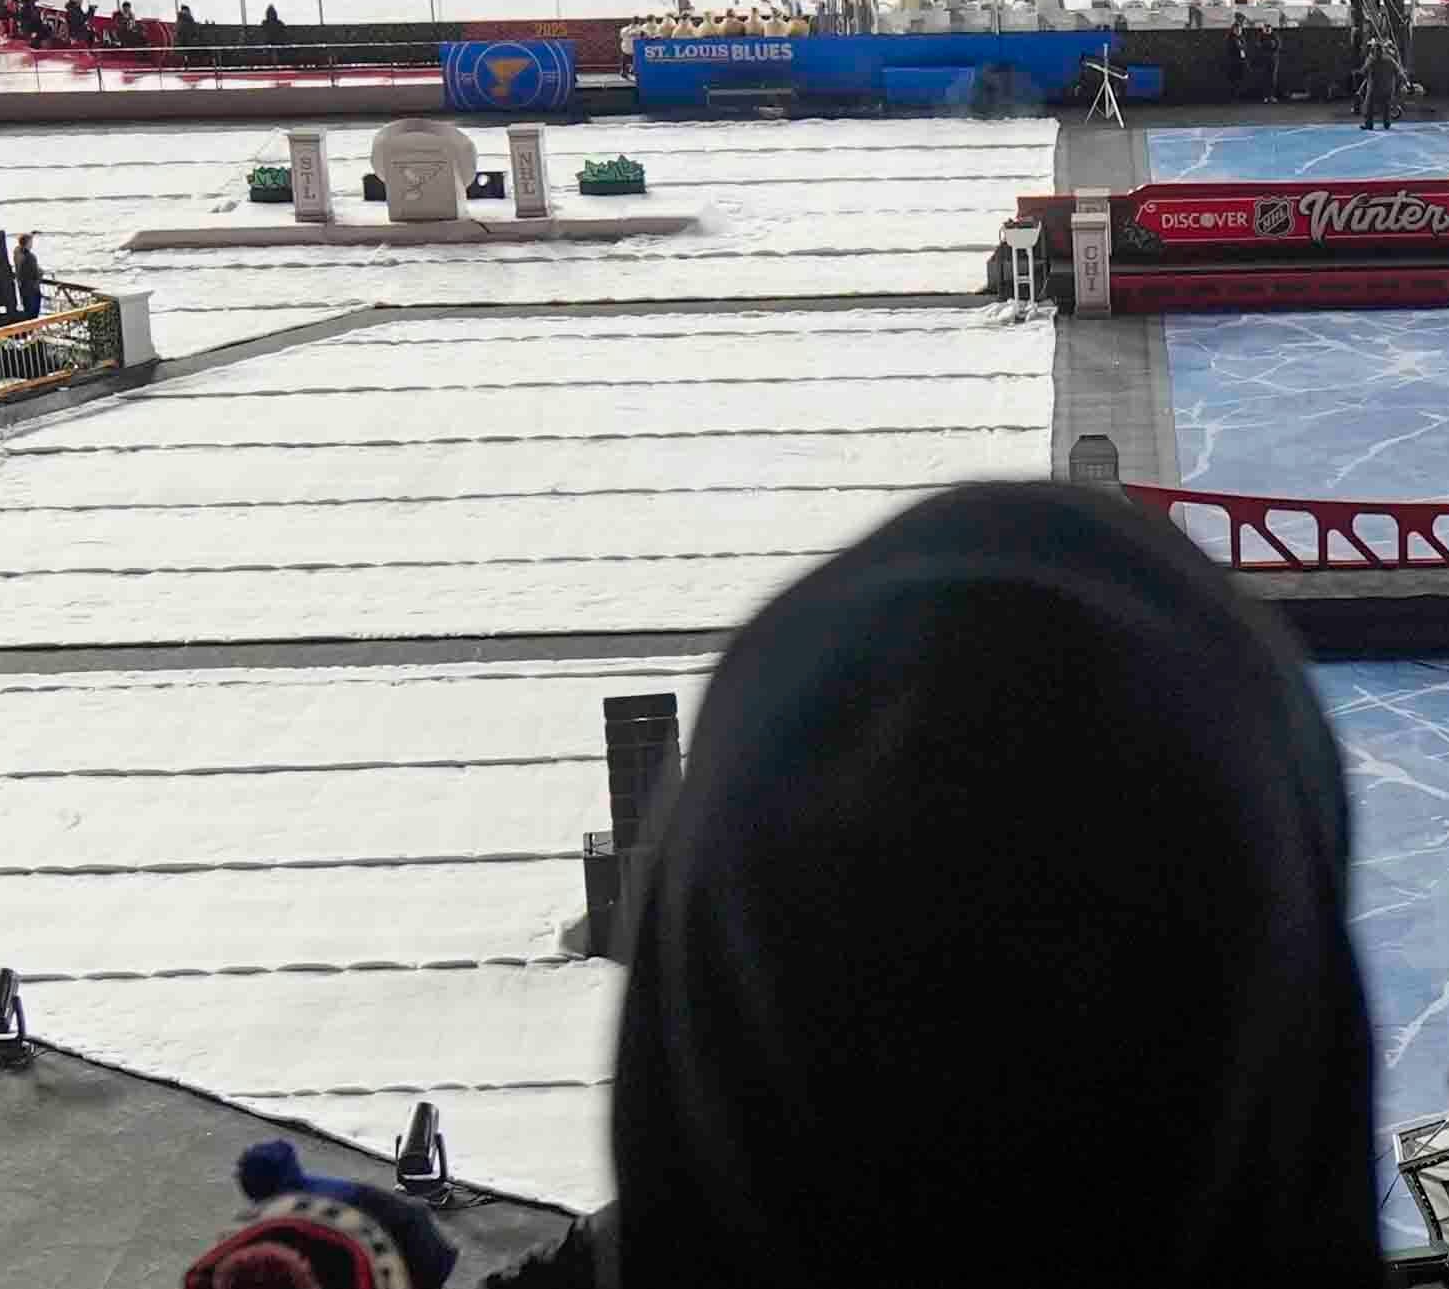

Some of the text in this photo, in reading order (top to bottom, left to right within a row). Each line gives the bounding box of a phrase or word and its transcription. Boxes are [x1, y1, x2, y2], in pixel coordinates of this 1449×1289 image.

[674, 44, 728, 59] LOUIS
[731, 44, 794, 61] BLUES
[1161, 211, 1249, 229] DISCOVER
